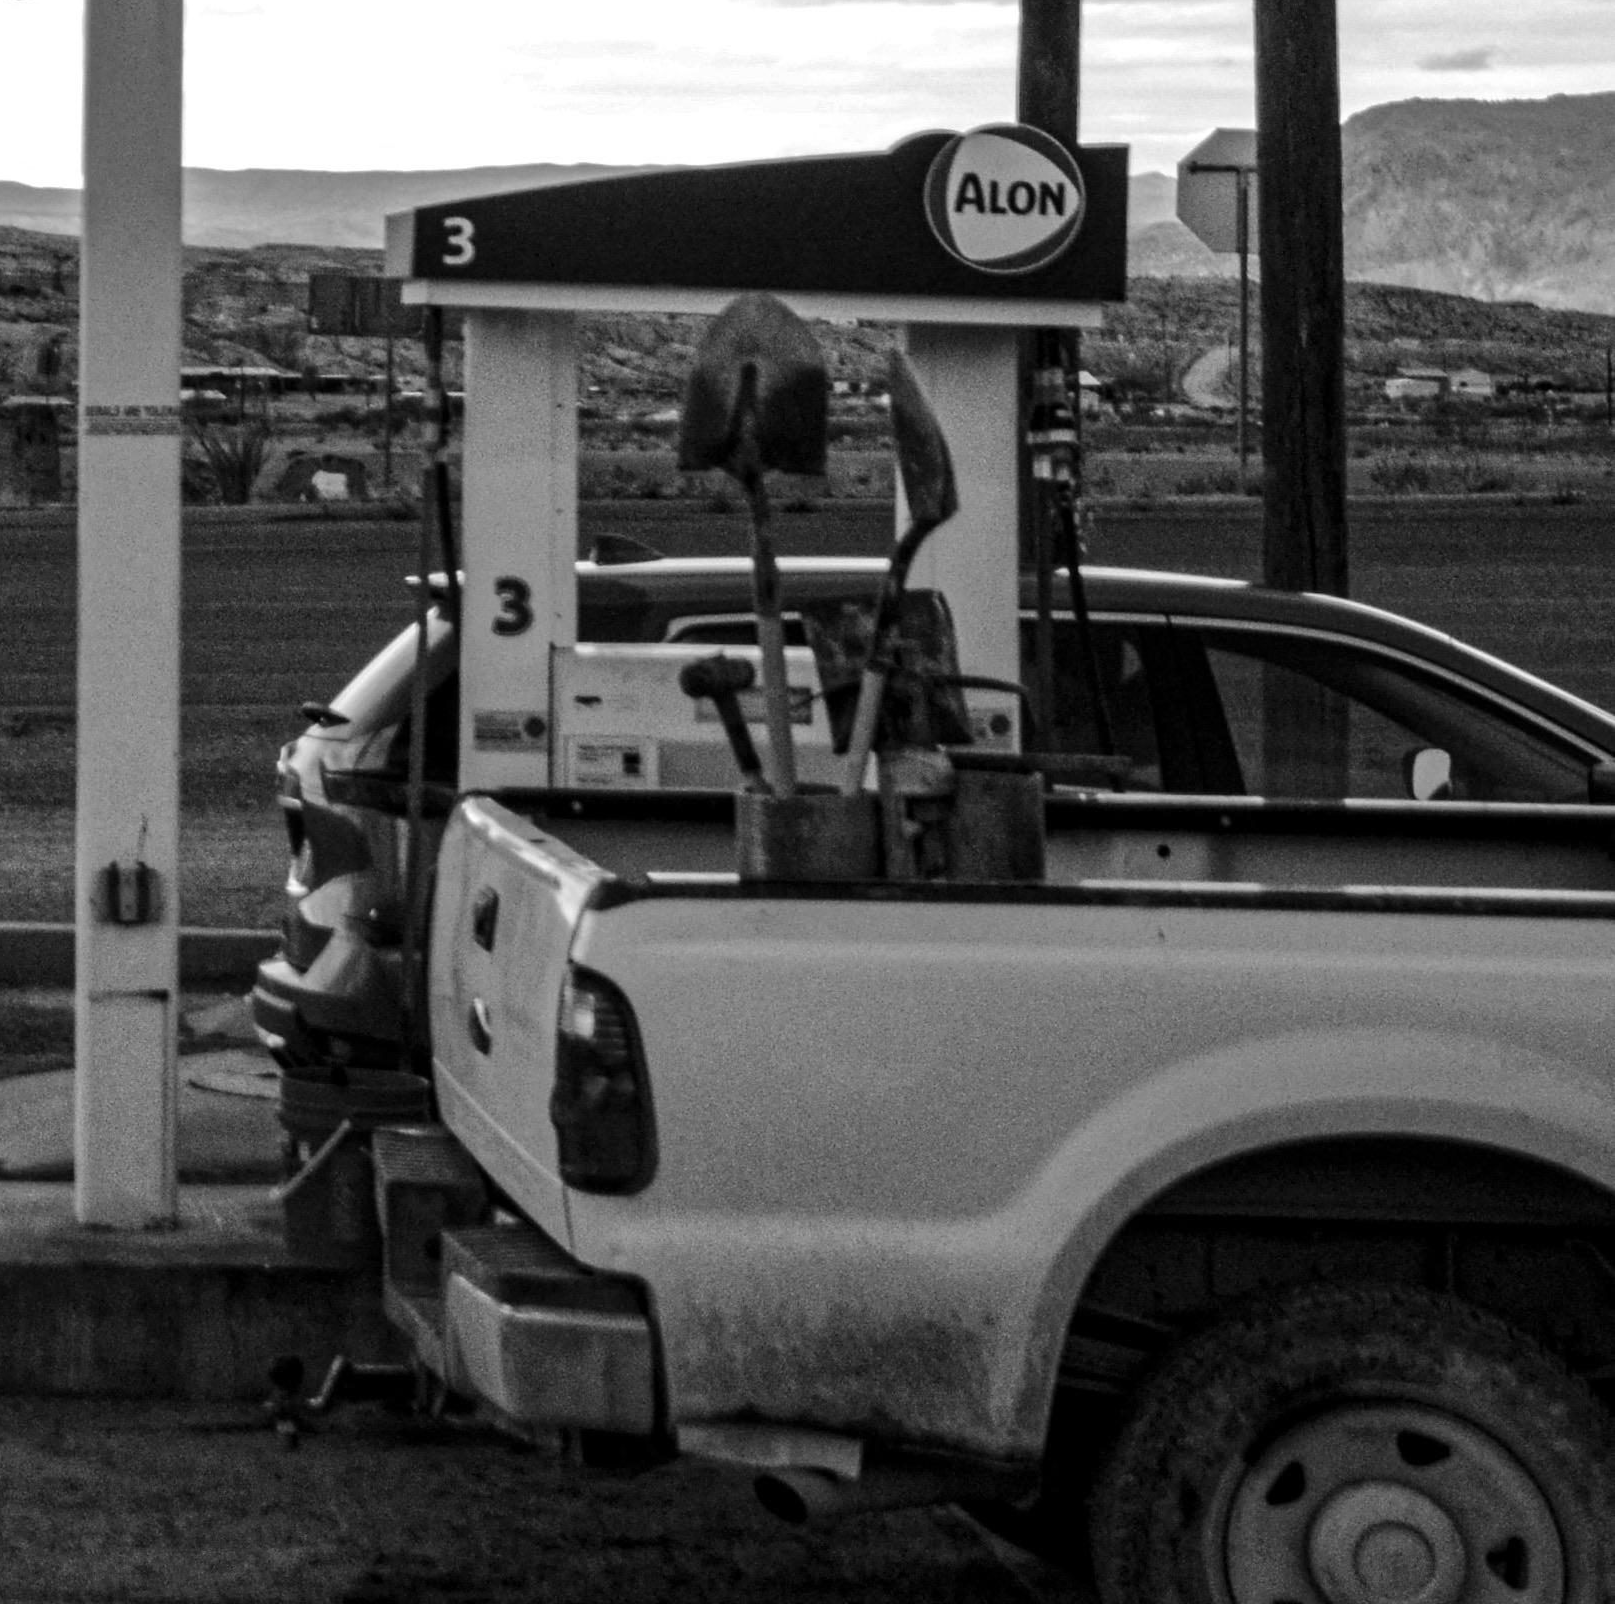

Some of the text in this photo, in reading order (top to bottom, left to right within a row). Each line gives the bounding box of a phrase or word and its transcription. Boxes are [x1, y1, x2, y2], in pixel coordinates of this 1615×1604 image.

[953, 171, 1067, 218] ALON
[441, 217, 476, 266] 3
[491, 577, 534, 636] 3
